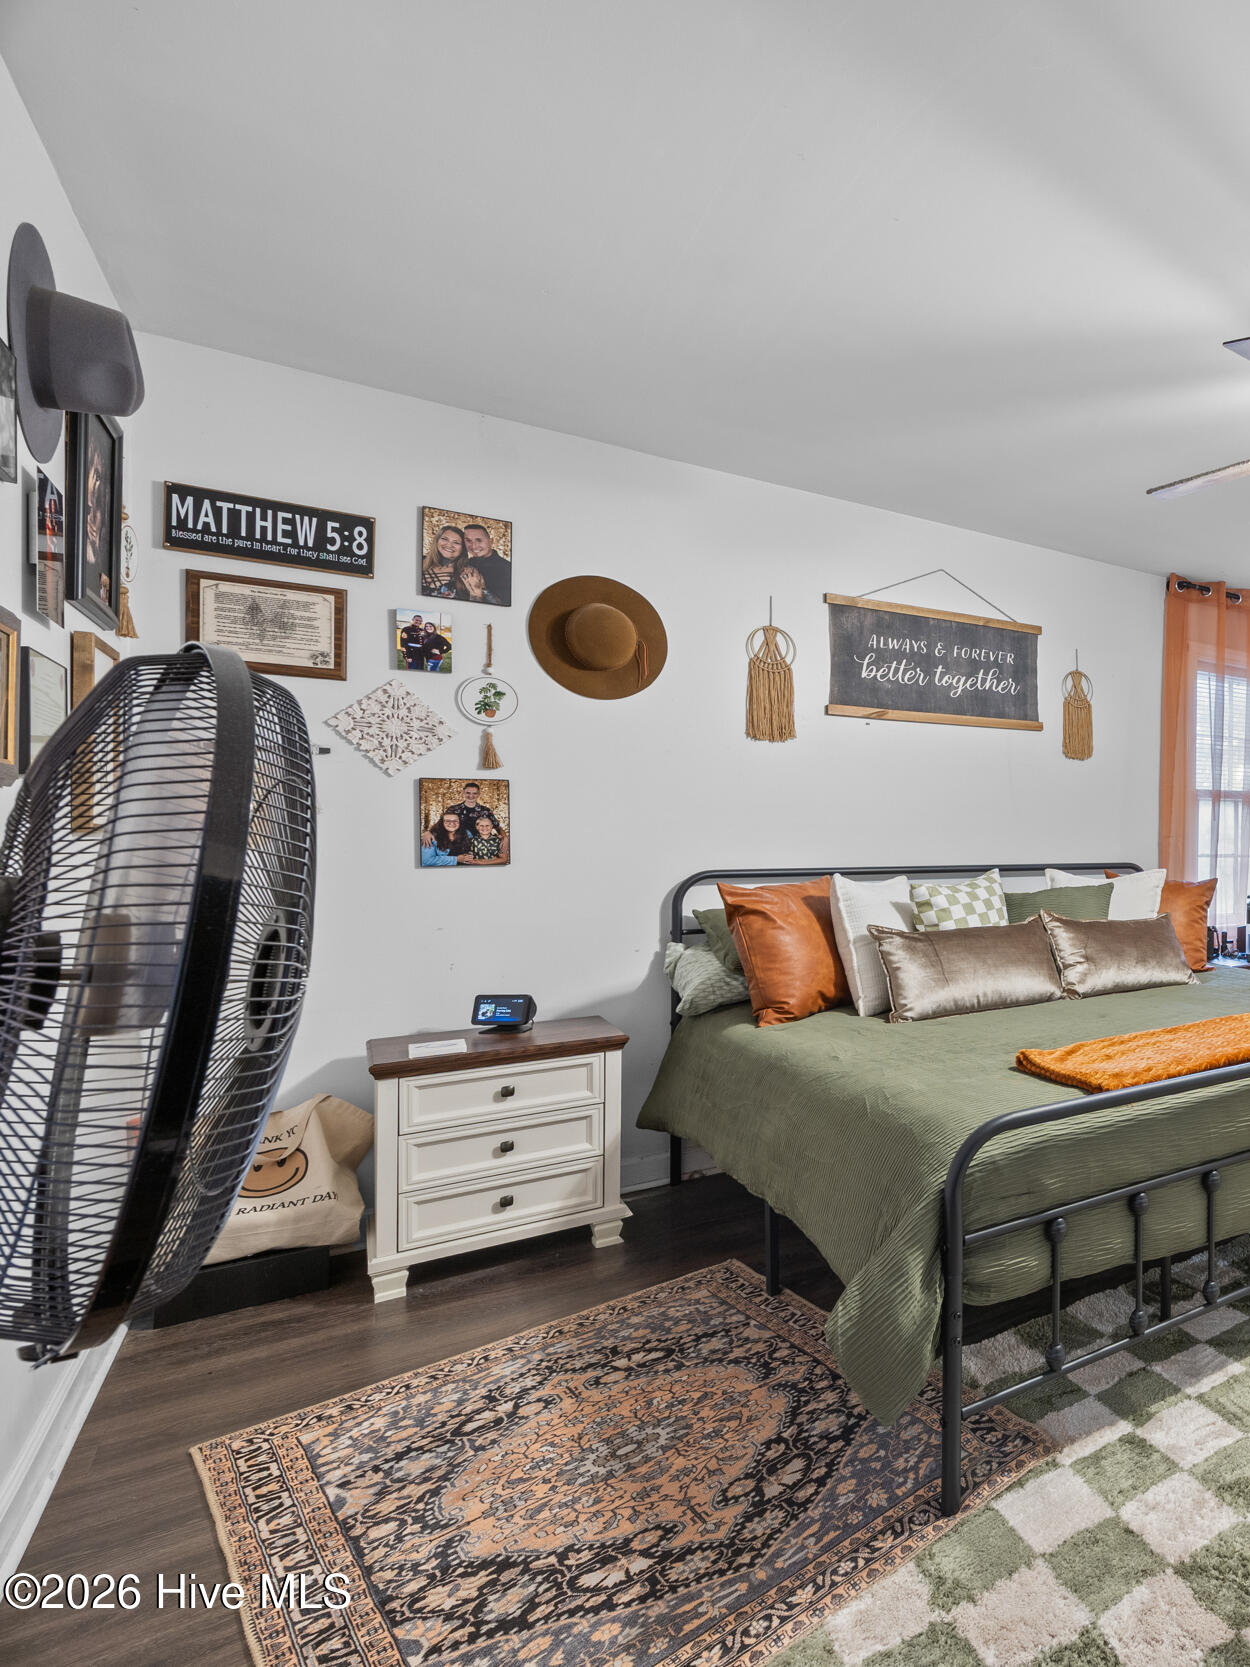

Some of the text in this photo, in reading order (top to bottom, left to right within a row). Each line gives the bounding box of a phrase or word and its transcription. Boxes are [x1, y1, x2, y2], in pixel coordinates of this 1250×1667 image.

[171, 493, 369, 556] MATTHEW 5:8
[171, 528, 202, 540] Blessed
[204, 534, 217, 542] are
[219, 536, 233, 545] the
[234, 539, 251, 548] pure
[253, 541, 260, 550] in
[287, 546, 299, 556] for
[300, 549, 318, 560] they
[320, 552, 338, 562] shall
[340, 555, 351, 563] see
[868, 634, 1015, 665] ALWAYS & FOREVER
[854, 652, 1020, 698] better together
[236, 1192, 338, 1215] RADIANT DAY
